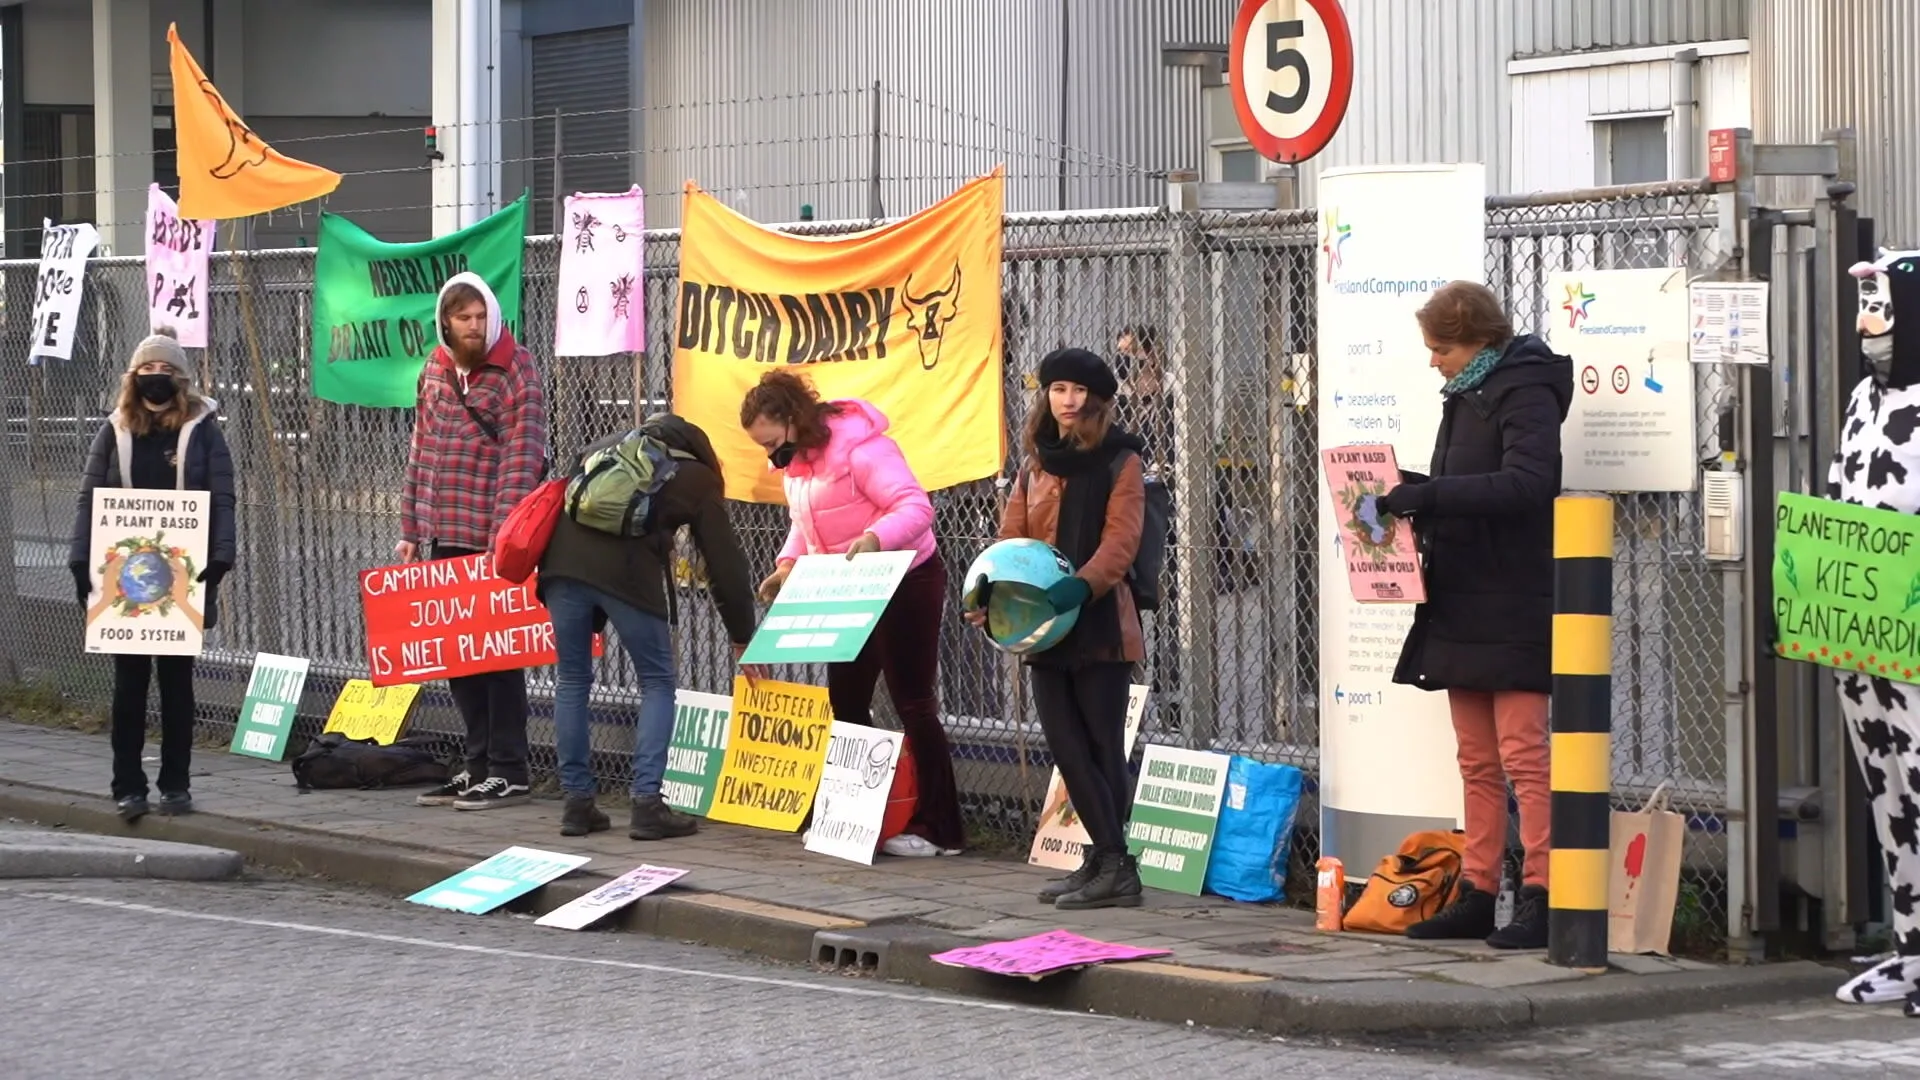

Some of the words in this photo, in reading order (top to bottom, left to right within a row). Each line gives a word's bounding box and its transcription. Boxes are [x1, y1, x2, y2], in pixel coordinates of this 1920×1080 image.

[1265, 19, 1310, 115] 5
[398, 315, 424, 357] OP
[678, 281, 782, 362] DITCH
[779, 287, 895, 364] DAIRY
[1617, 371, 1625, 387] 5
[1388, 415, 1401, 433] bij
[1330, 453, 1338, 464] A
[1338, 452, 1363, 465] PLANT
[1364, 452, 1387, 464] BASED
[103, 498, 175, 512] TRANSITION
[182, 500, 198, 513] TO
[100, 515, 109, 527] A
[115, 515, 154, 529] PLANT
[160, 516, 199, 530] BASED
[1776, 504, 1915, 557] PLANETPROOF
[364, 562, 459, 596] CAMPINA
[1358, 562, 1387, 573] LOVING
[1388, 562, 1415, 573] WORLD
[1816, 557, 1880, 602] KIES
[409, 594, 477, 628] JOUW
[489, 585, 544, 615] MEL
[100, 627, 134, 641] FOOD
[140, 629, 186, 642] SYSTEM
[371, 645, 393, 676] IS
[402, 637, 445, 668] NIET
[457, 621, 556, 662] PLANETPR
[743, 687, 815, 718] INVESTEER
[1348, 691, 1373, 707] poort
[1377, 690, 1383, 705] 1
[671, 704, 709, 746] AKE
[708, 710, 729, 749] IT
[738, 711, 827, 752] TOEKOMST
[666, 746, 708, 776] CLIMATE
[733, 748, 798, 779] INVESTEER
[801, 763, 816, 781] IN
[719, 775, 807, 815] PLANTAARDIG
[1040, 836, 1063, 853] FOOD
[1065, 839, 1084, 858] SYST
[1171, 828, 1209, 852] OVERSTAP
